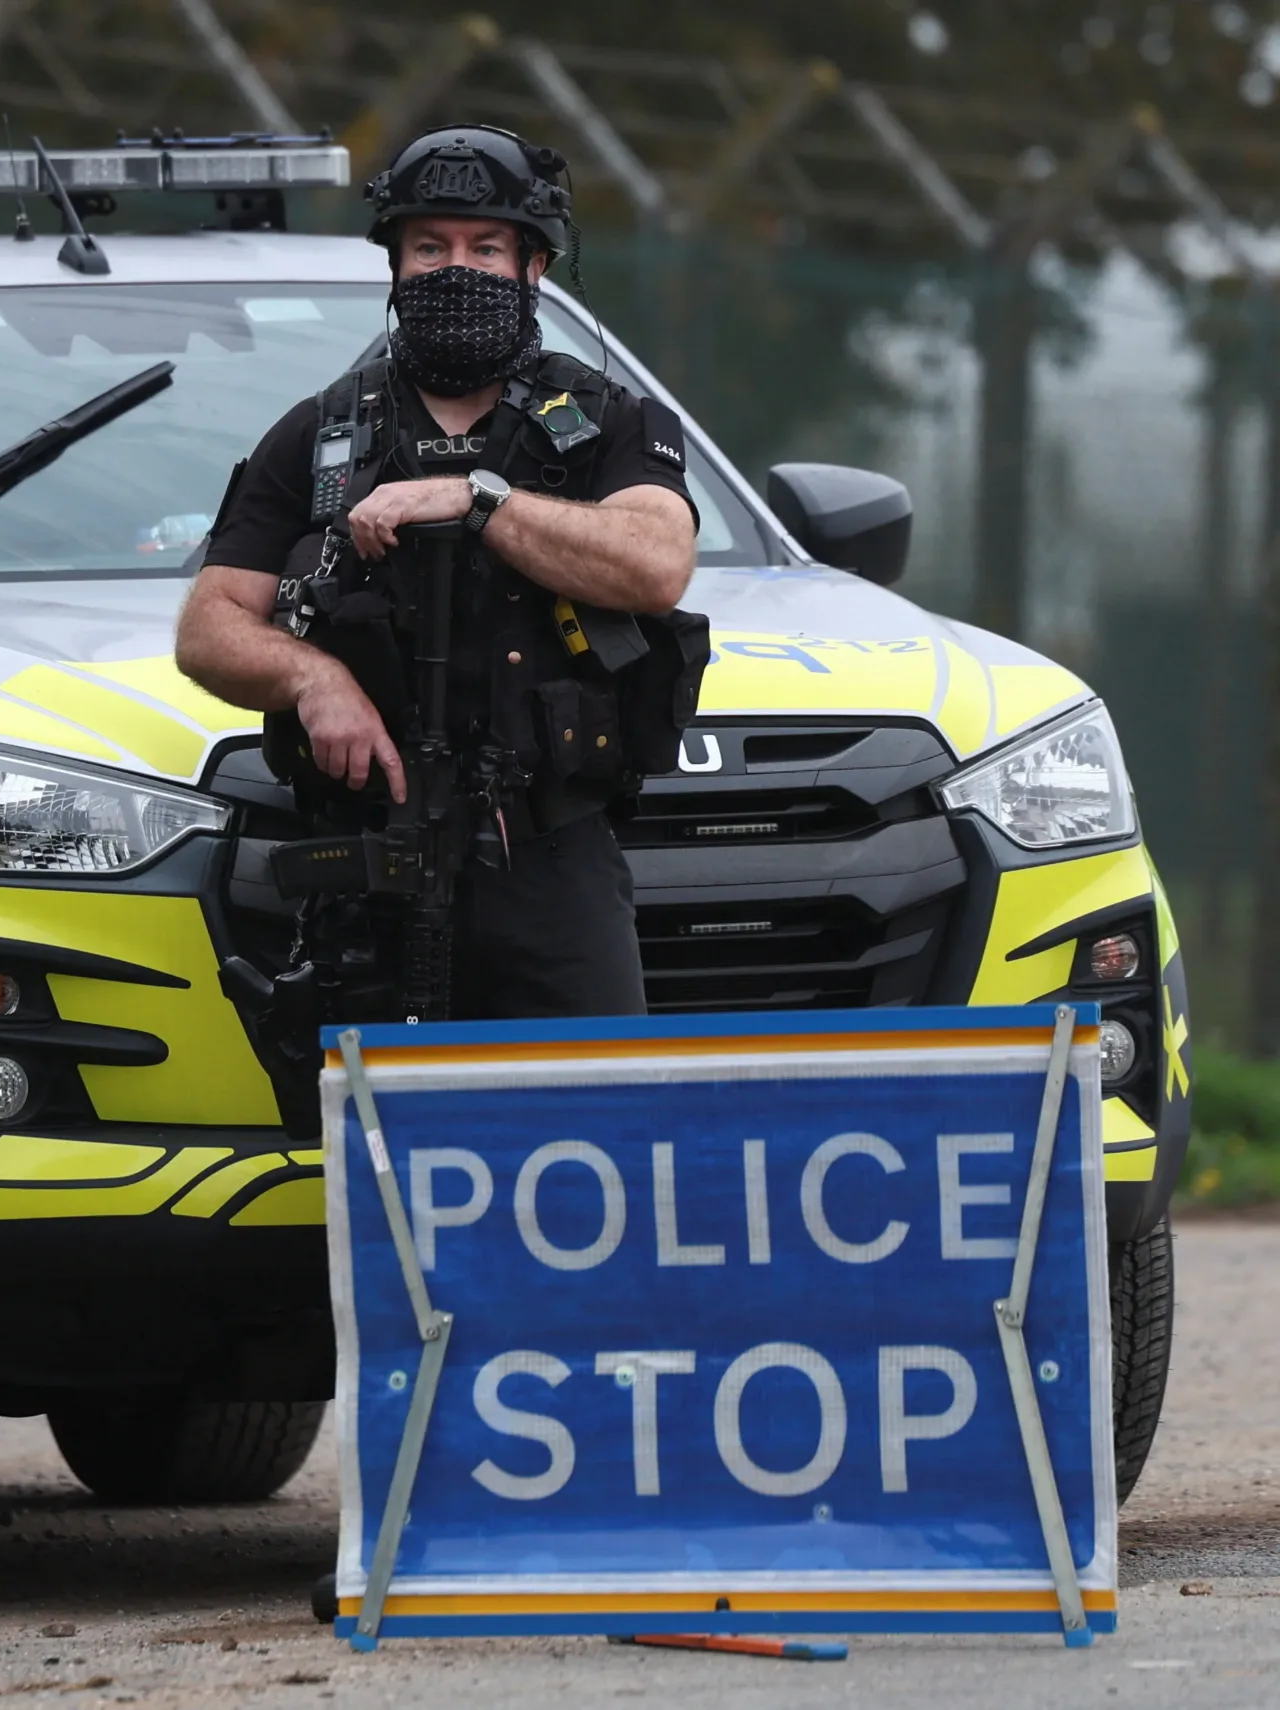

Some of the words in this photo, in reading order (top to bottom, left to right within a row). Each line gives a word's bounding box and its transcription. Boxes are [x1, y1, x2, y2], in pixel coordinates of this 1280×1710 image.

[417, 437, 487, 456] POLIC
[408, 1132, 1024, 1272] POLICE
[470, 1341, 979, 1502] STOP
